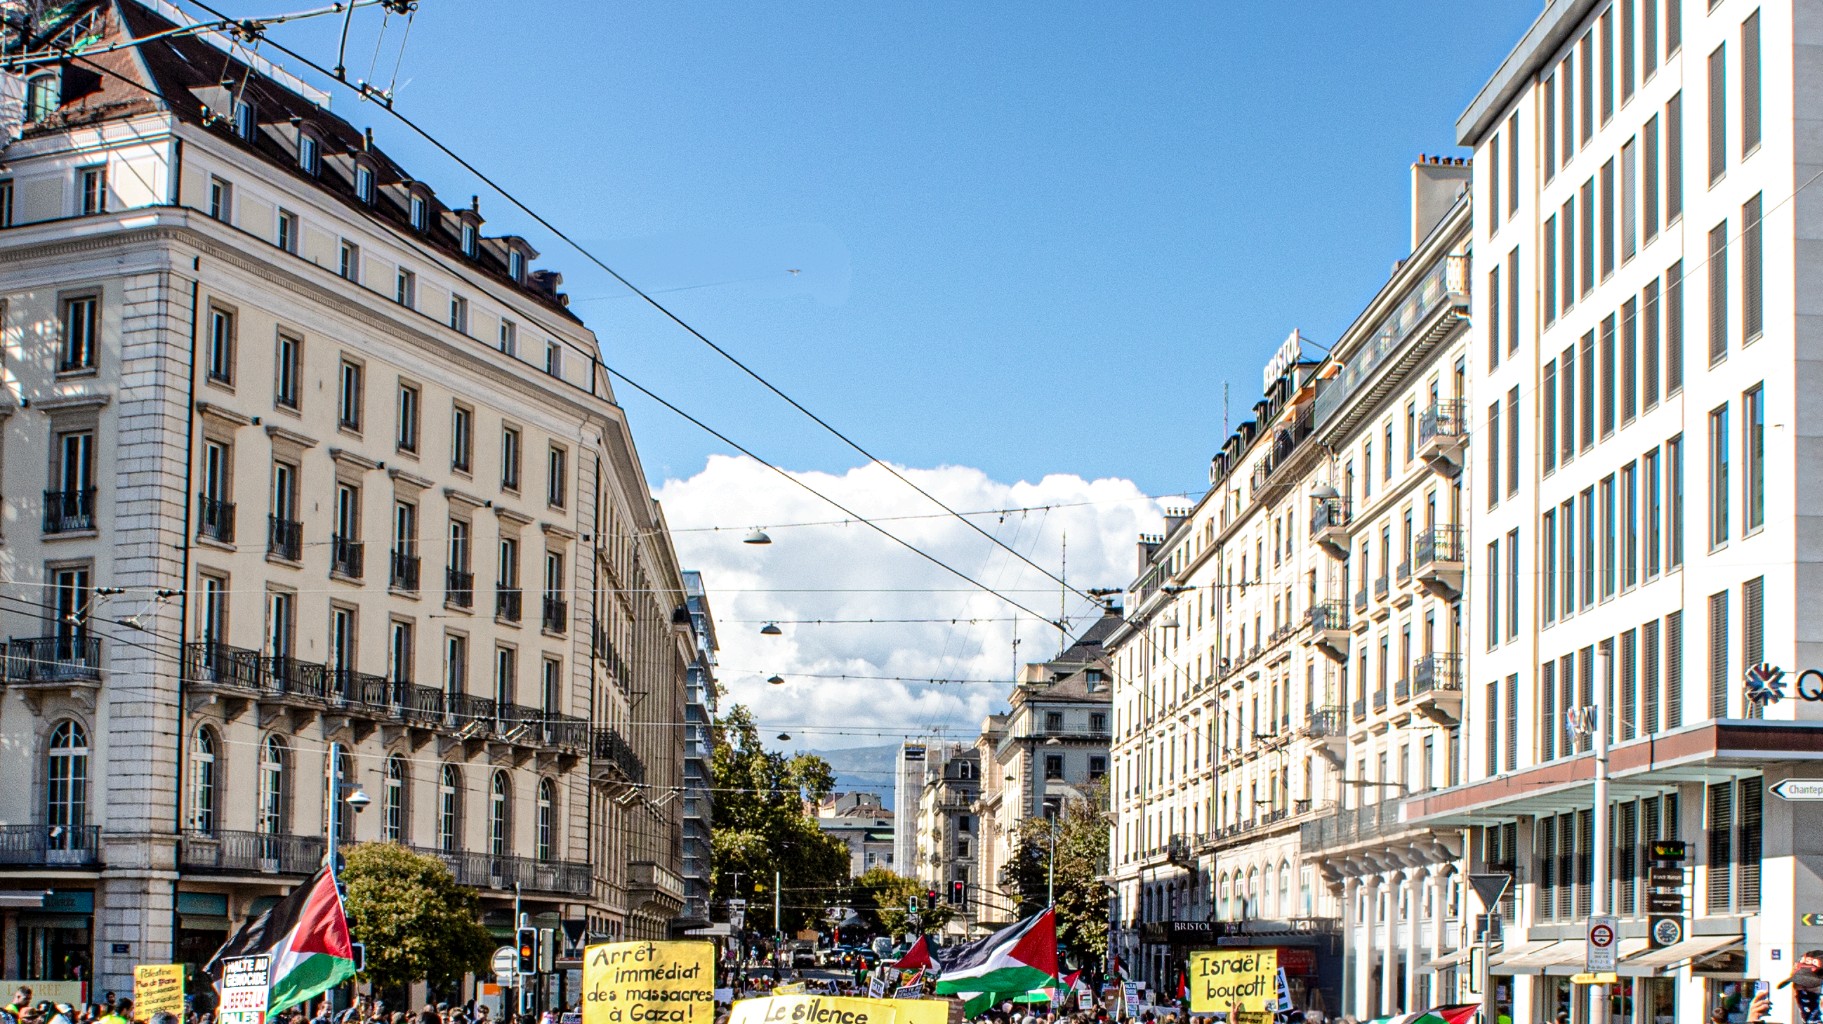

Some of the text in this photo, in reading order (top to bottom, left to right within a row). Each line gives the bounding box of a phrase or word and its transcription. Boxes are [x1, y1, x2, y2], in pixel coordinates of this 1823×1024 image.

[1174, 922, 1212, 932] BRISTOL
[227, 958, 268, 973] HALTE AU
[592, 942, 657, 967] Arrêt
[1199, 953, 1261, 977] Israël
[615, 962, 700, 984] immédiat
[587, 983, 714, 1003] des massacres
[1206, 974, 1266, 1007] boycott
[609, 1007, 622, 1023] à
[764, 999, 786, 1022] Le
